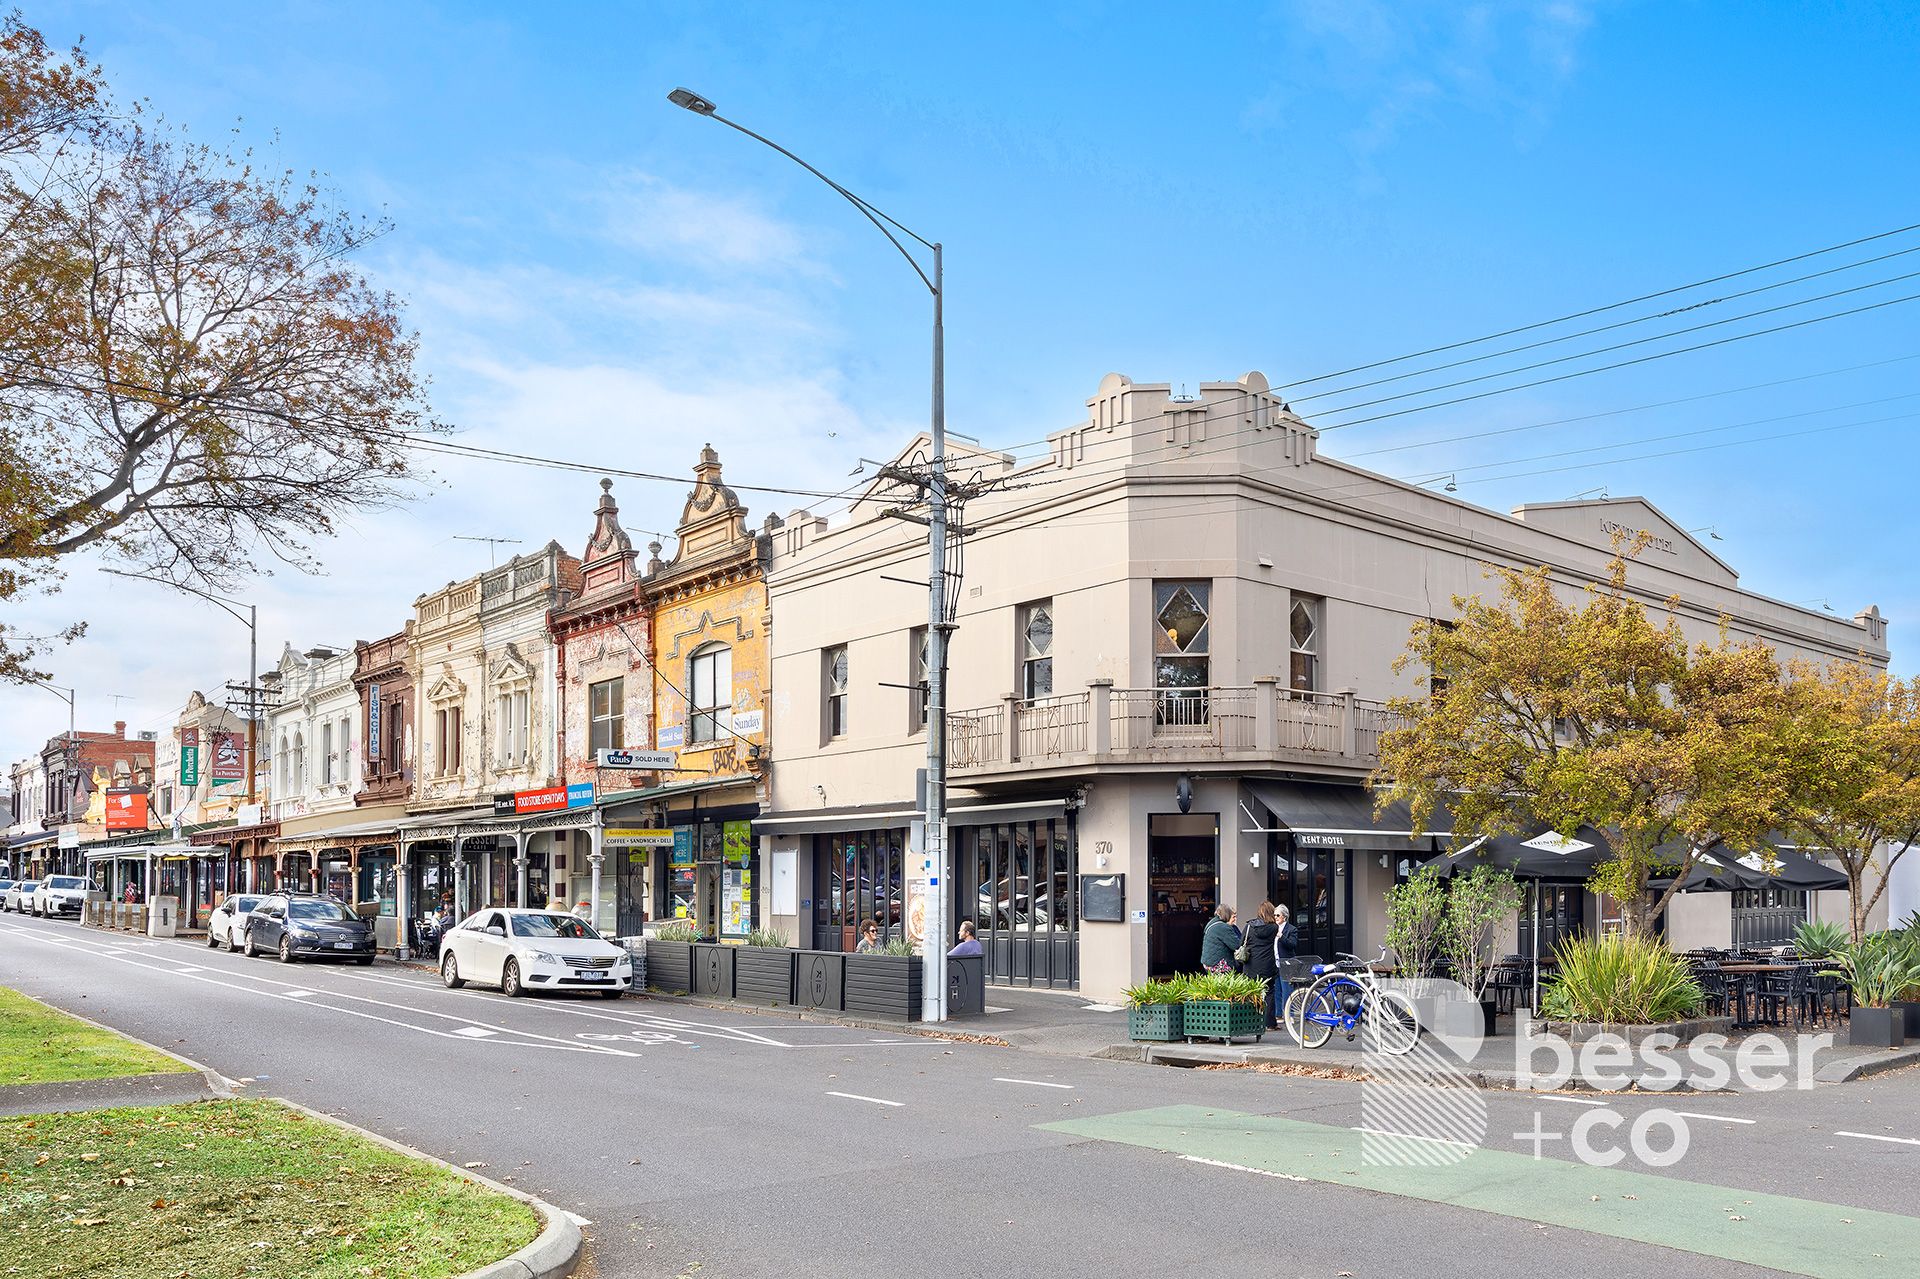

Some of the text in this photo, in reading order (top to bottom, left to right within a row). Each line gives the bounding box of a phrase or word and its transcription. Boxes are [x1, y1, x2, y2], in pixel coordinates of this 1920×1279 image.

[734, 715, 761, 730] Sunday
[518, 796, 528, 807] FOOD
[529, 795, 540, 806] STORE
[541, 794, 552, 804] OPEN
[555, 792, 566, 802] DAYS
[1095, 841, 1112, 854] 370
[1302, 836, 1344, 845] KENT HOTEL
